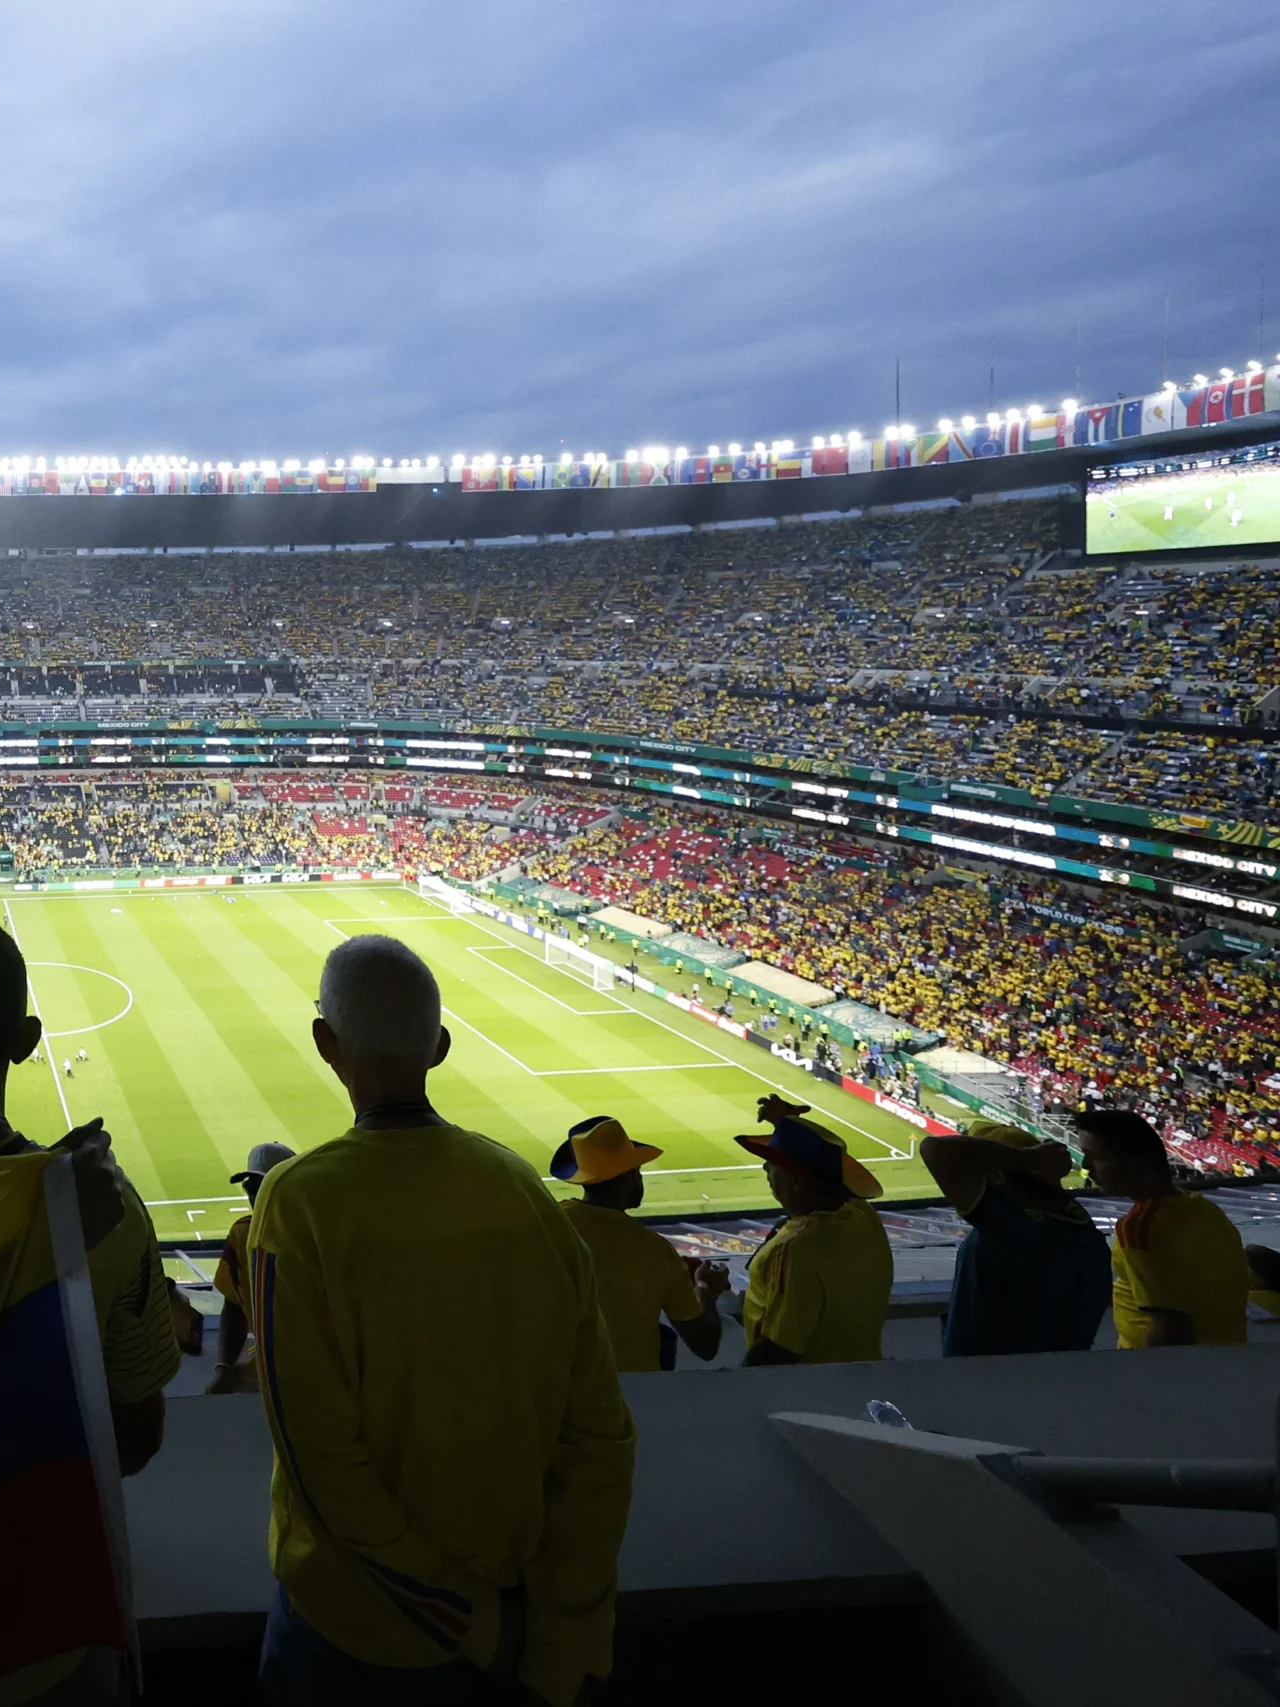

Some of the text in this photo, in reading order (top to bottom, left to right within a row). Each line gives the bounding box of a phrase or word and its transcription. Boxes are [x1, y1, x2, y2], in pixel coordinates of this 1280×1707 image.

[639, 740, 697, 753] MEXICO CITY
[1236, 860, 1277, 877] CITY
[1236, 899, 1277, 917] CITY
[1063, 913, 1086, 924] CUP
[875, 1092, 927, 1128] Lenovo
